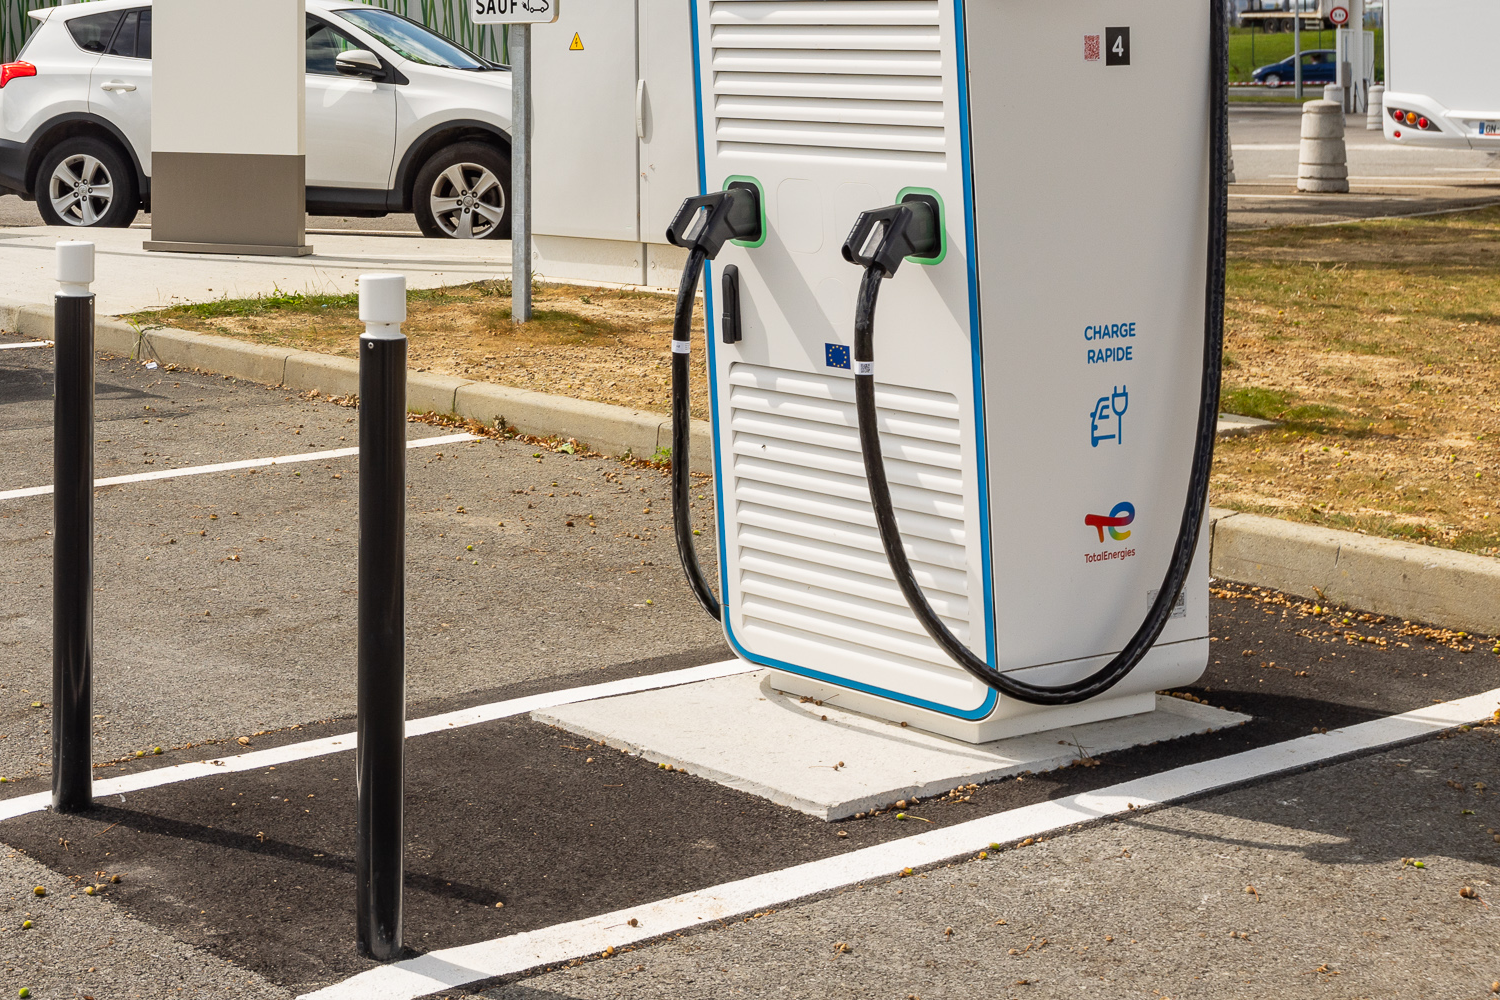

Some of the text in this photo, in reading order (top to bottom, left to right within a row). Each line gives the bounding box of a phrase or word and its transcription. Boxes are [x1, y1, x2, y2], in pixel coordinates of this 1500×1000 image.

[1112, 35, 1124, 57] 4
[1084, 322, 1136, 341] CHARGE
[1087, 346, 1133, 364] RAPIDE
[1084, 547, 1136, 563] TotalEnergies
